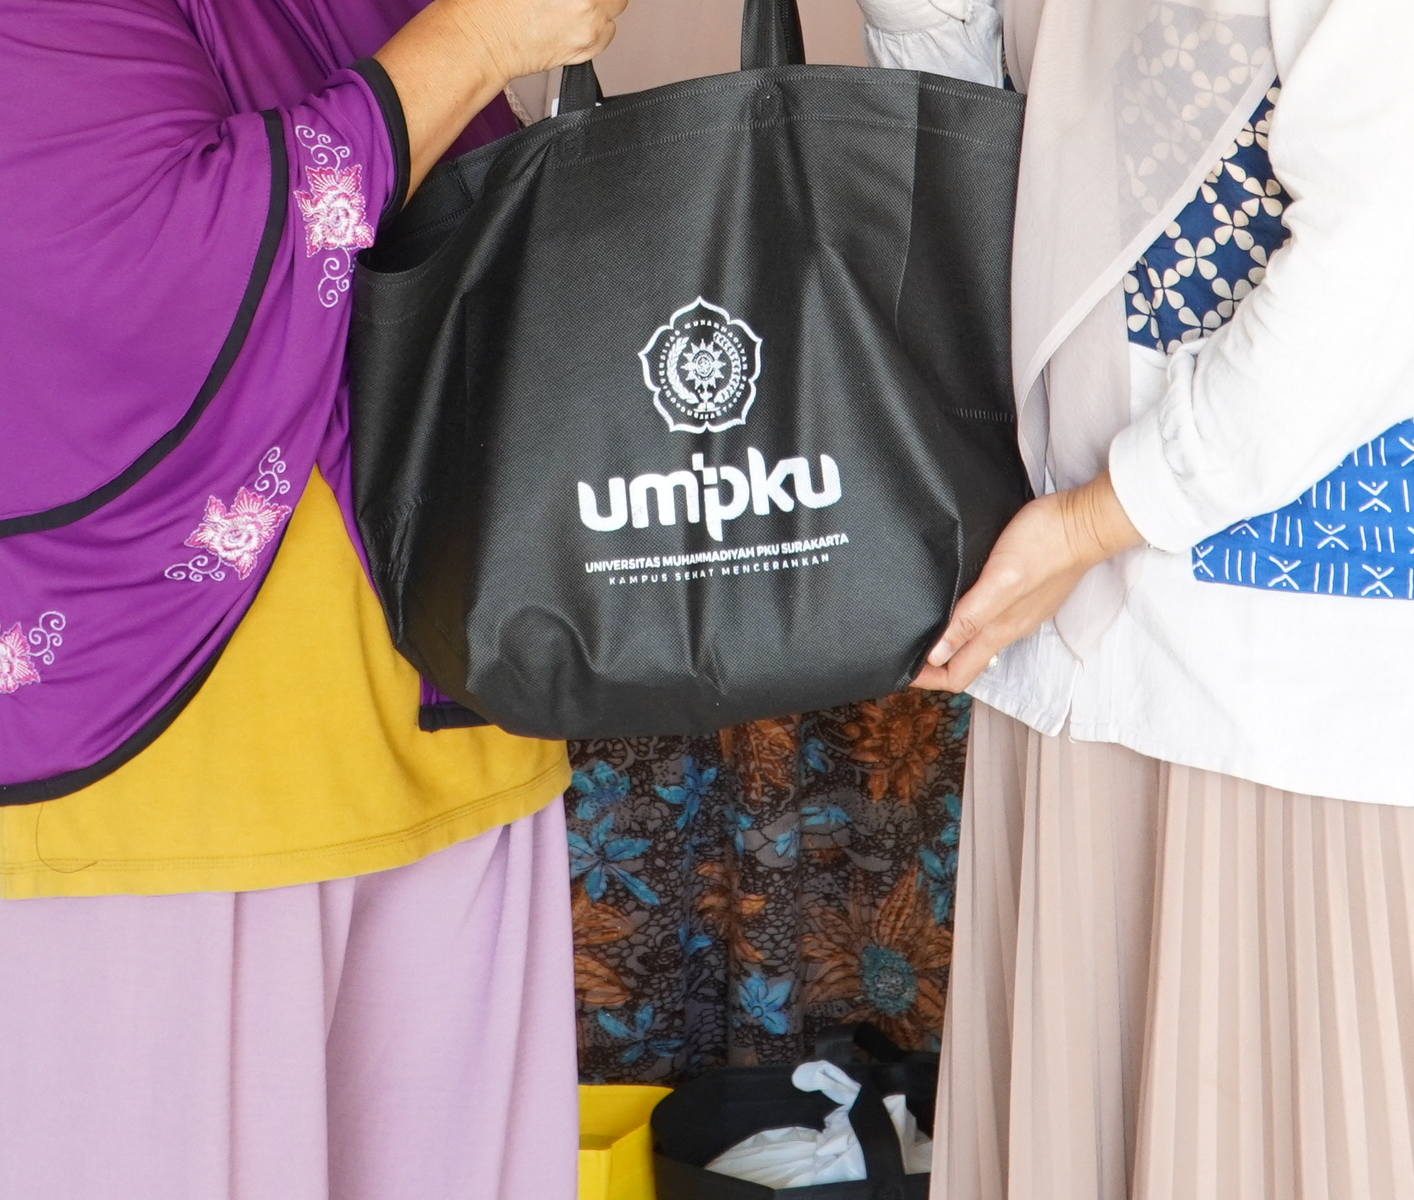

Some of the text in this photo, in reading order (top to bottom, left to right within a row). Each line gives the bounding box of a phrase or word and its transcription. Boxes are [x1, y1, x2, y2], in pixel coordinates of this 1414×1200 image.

[585, 533, 849, 573] UNIVERSITAS MUHAMMADIYAH PKU SURAKARTA
[608, 553, 830, 585] KAMPUS SEHAT MENCERAHKAN
